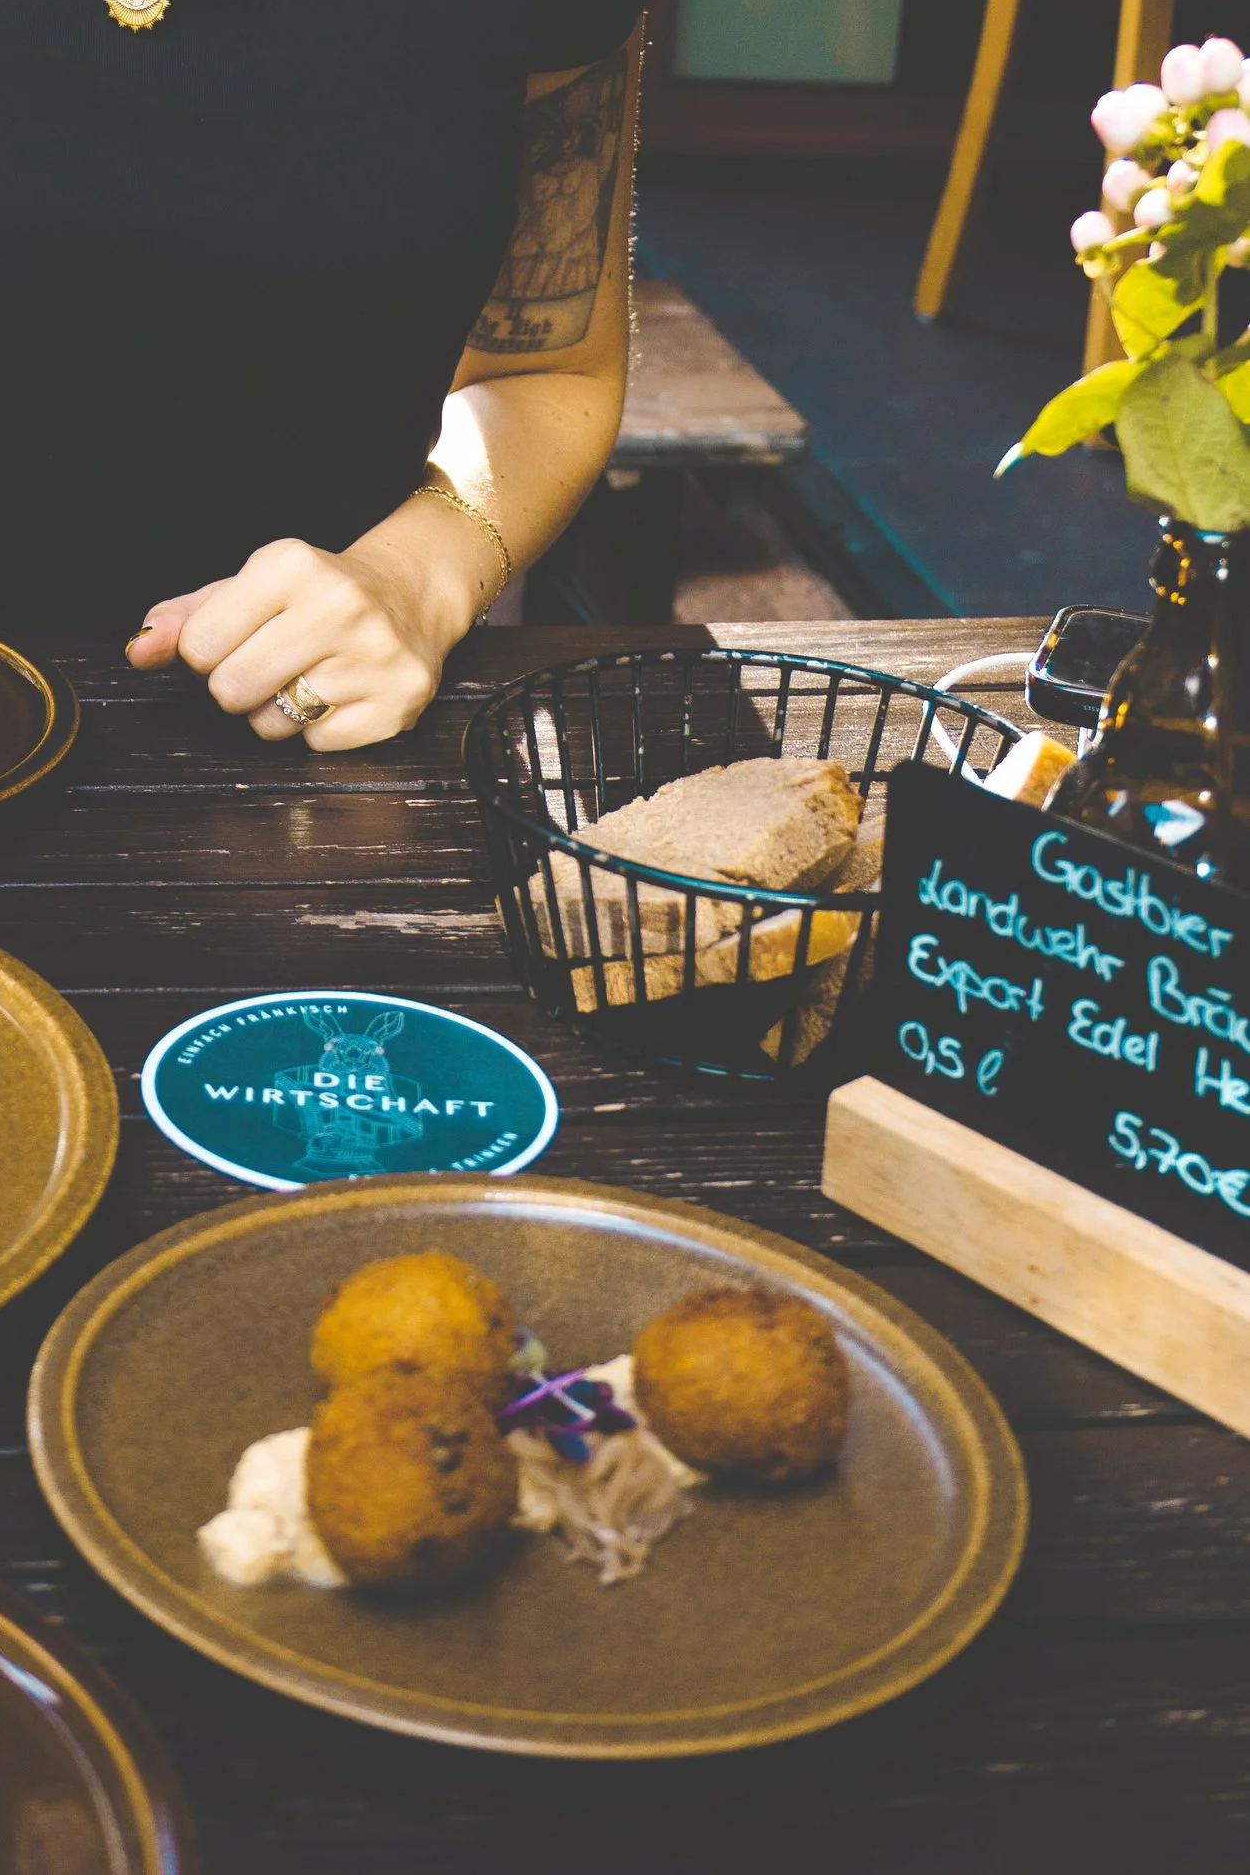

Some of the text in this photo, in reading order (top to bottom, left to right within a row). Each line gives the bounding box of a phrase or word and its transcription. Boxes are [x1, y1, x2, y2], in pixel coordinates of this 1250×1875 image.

[919, 859, 1125, 982] Landwehr
[1031, 831, 1234, 958] Gastbier
[177, 1023, 232, 1065] EINFACH
[908, 934, 1045, 1022] Export
[1067, 999, 1159, 1072] Edel
[202, 1083, 495, 1118] WIRTSCHAFT
[312, 1071, 388, 1092] DIE
[898, 1021, 966, 1080] 0,5
[1108, 1111, 1250, 1217] 5,70€
[451, 1130, 519, 1172] TRINKEN
